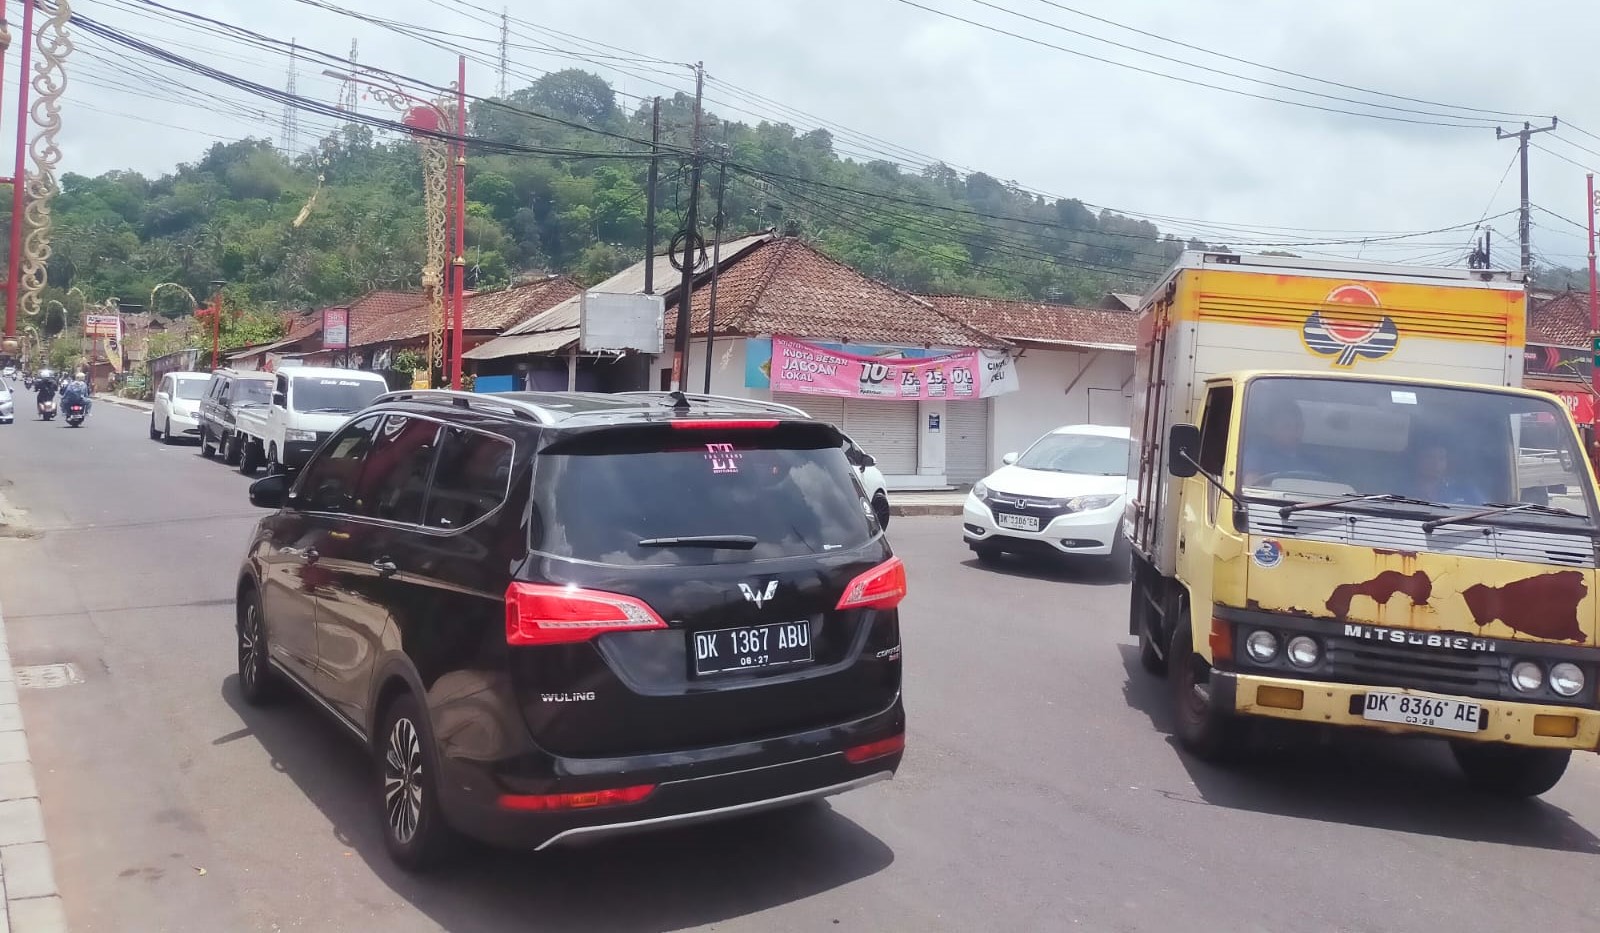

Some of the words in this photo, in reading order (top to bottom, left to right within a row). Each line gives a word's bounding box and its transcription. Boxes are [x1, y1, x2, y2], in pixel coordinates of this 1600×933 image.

[783, 348, 814, 361] KUOTA
[816, 354, 849, 366] BESAR
[781, 370, 814, 382] LOKAL
[782, 359, 838, 376] JAGOAN
[697, 634, 719, 659] DK
[731, 627, 769, 654] 1367
[779, 623, 808, 649] ABU
[1344, 624, 1496, 652] MITSUBISHI
[540, 691, 596, 702] WULING
[1366, 694, 1389, 711] DK
[1399, 697, 1444, 718] 8366
[1454, 703, 1478, 723] AE
